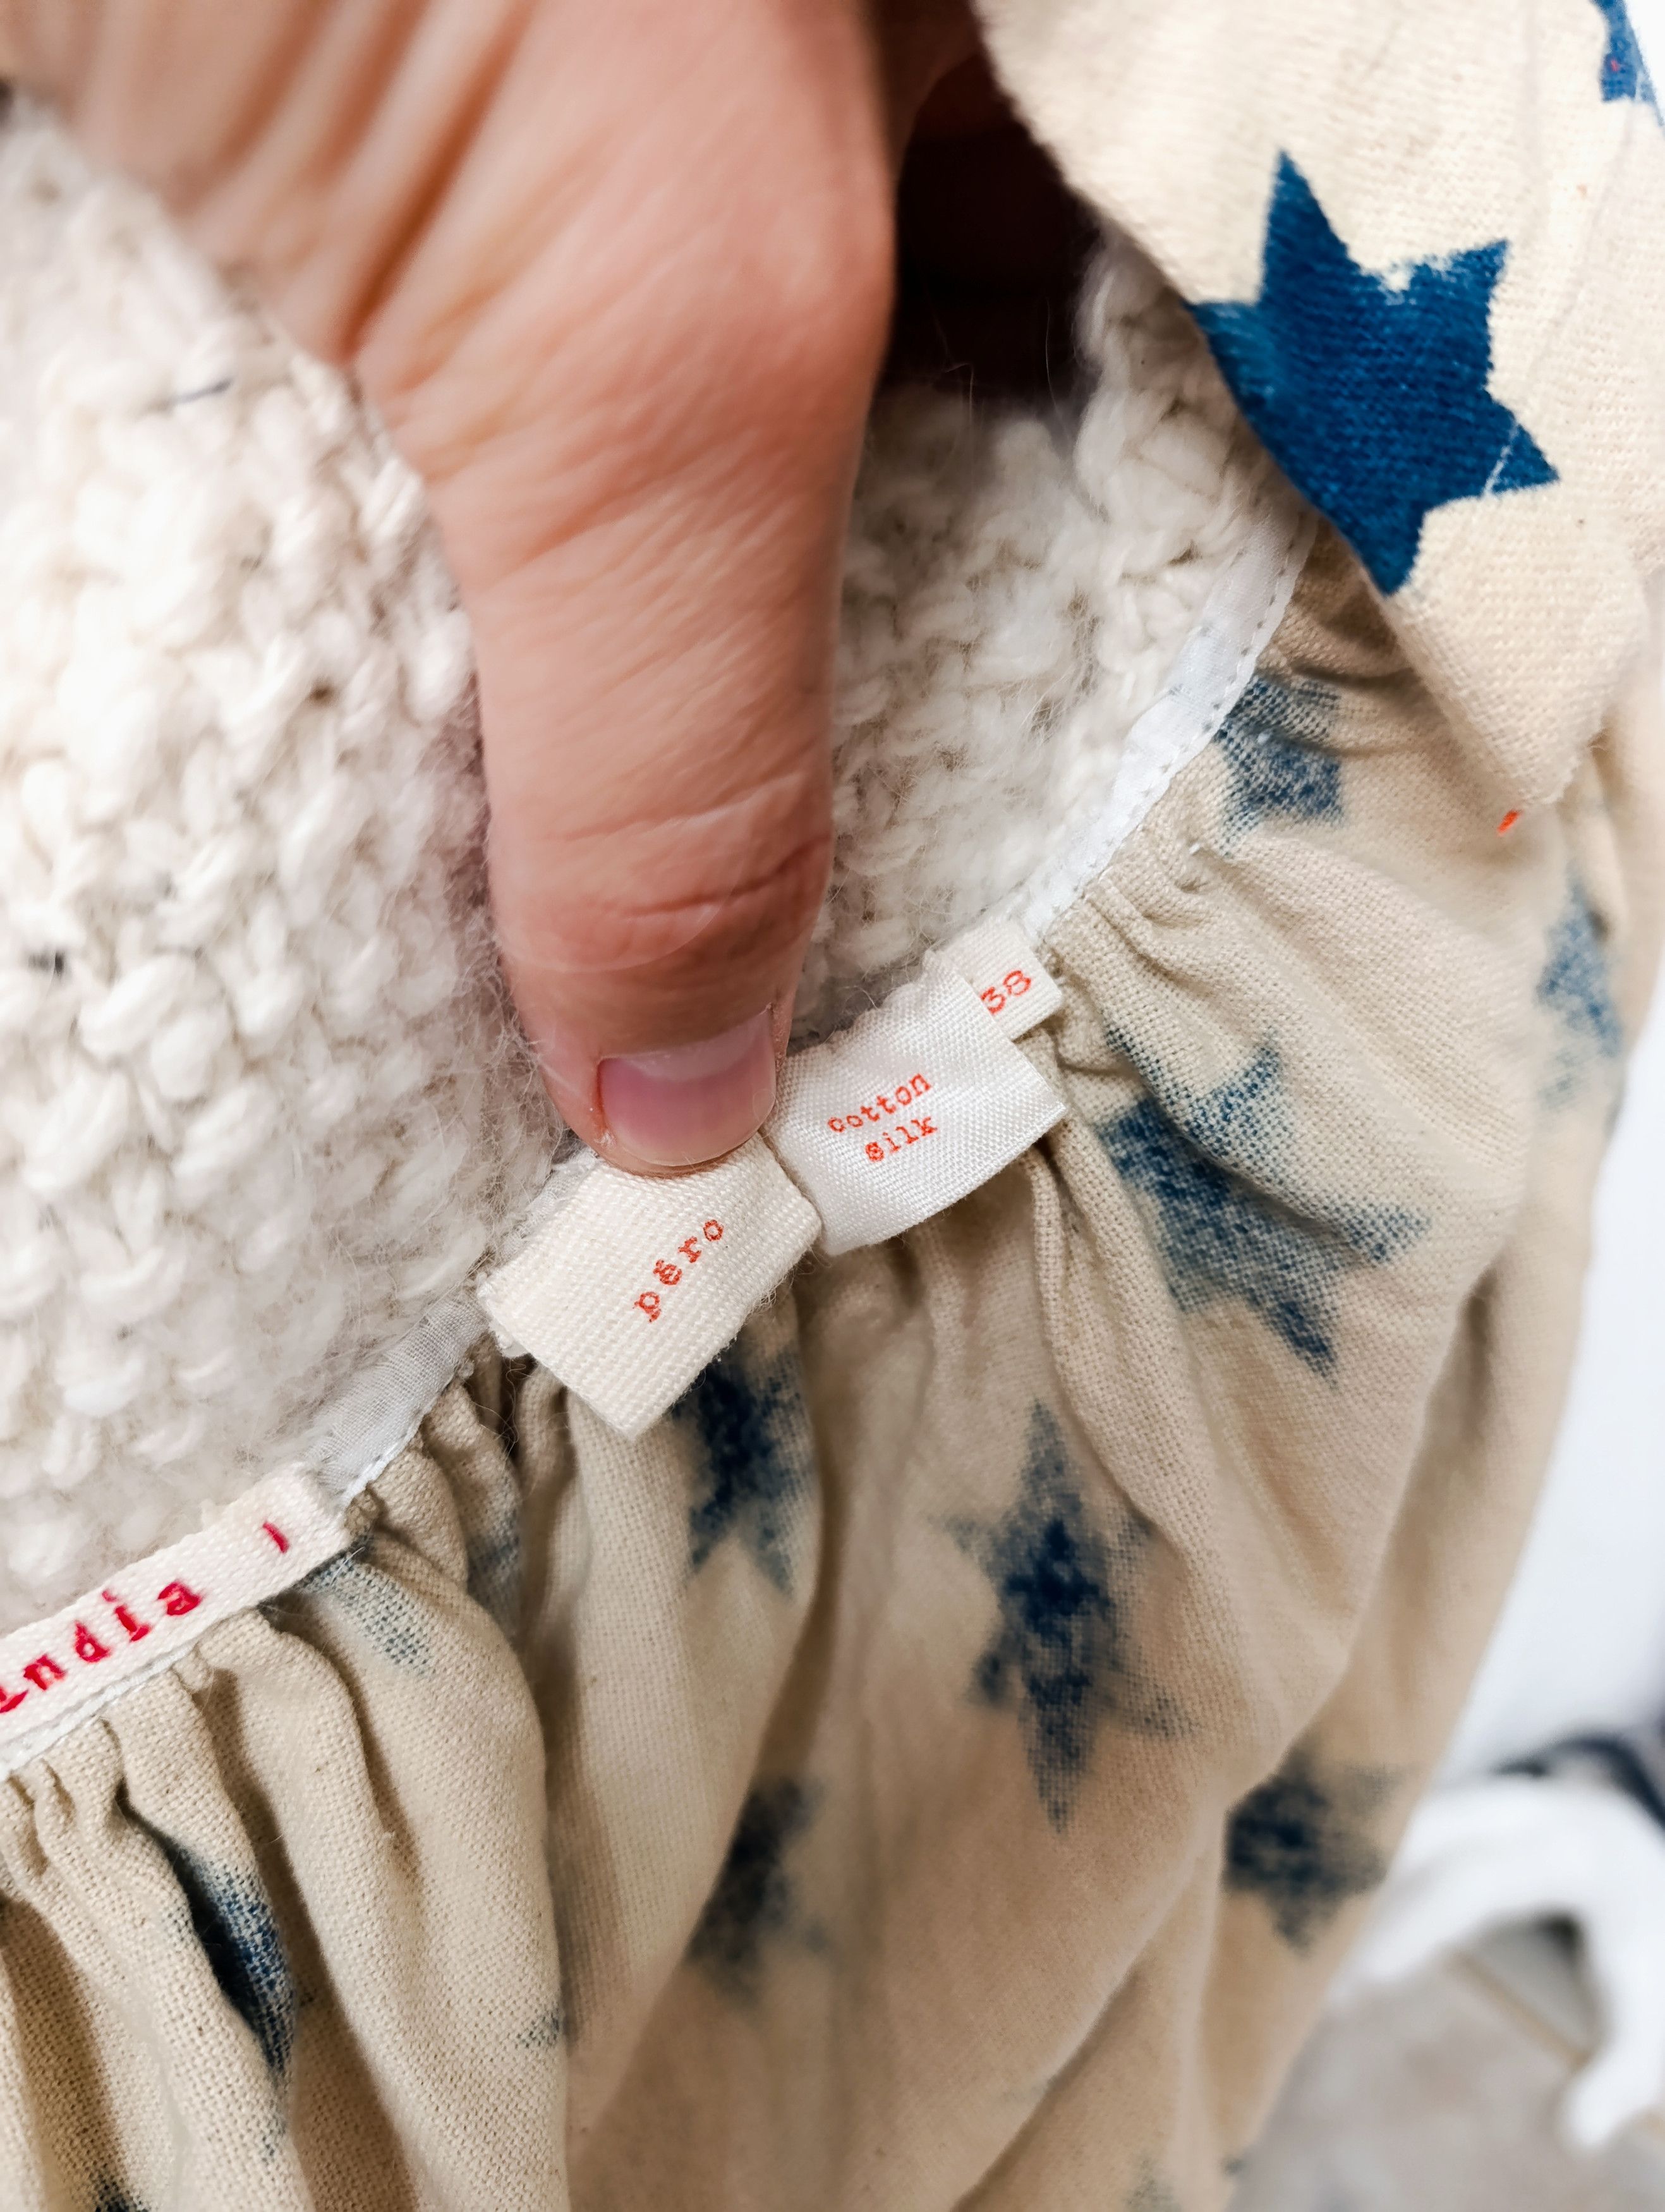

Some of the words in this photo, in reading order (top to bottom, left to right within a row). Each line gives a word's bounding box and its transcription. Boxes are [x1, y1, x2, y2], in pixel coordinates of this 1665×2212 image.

[979, 969, 1032, 1015] 38
[827, 1073, 931, 1133] cotton
[864, 1117, 938, 1162] silk
[633, 1218, 724, 1323] péro
